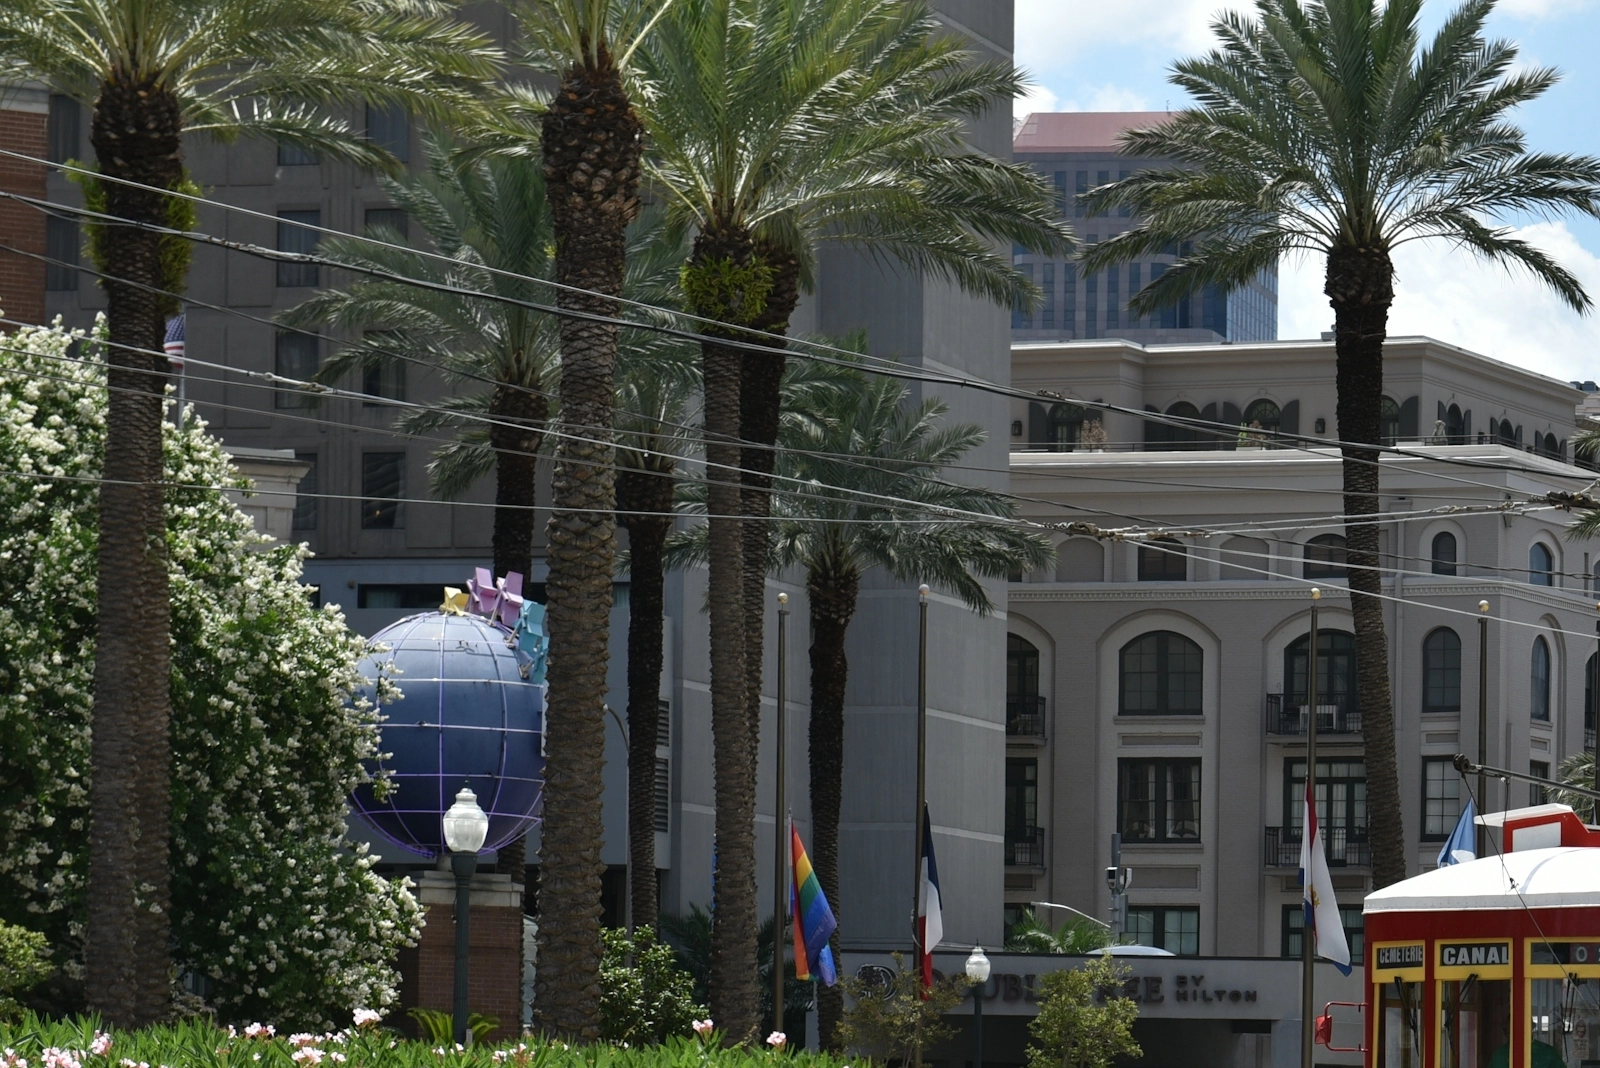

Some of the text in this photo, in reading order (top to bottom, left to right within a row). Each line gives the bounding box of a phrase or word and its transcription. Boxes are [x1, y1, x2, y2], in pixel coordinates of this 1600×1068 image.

[1443, 946, 1509, 965] CANAL
[1176, 975, 1204, 987] BY
[1176, 989, 1257, 1002] HILTON
